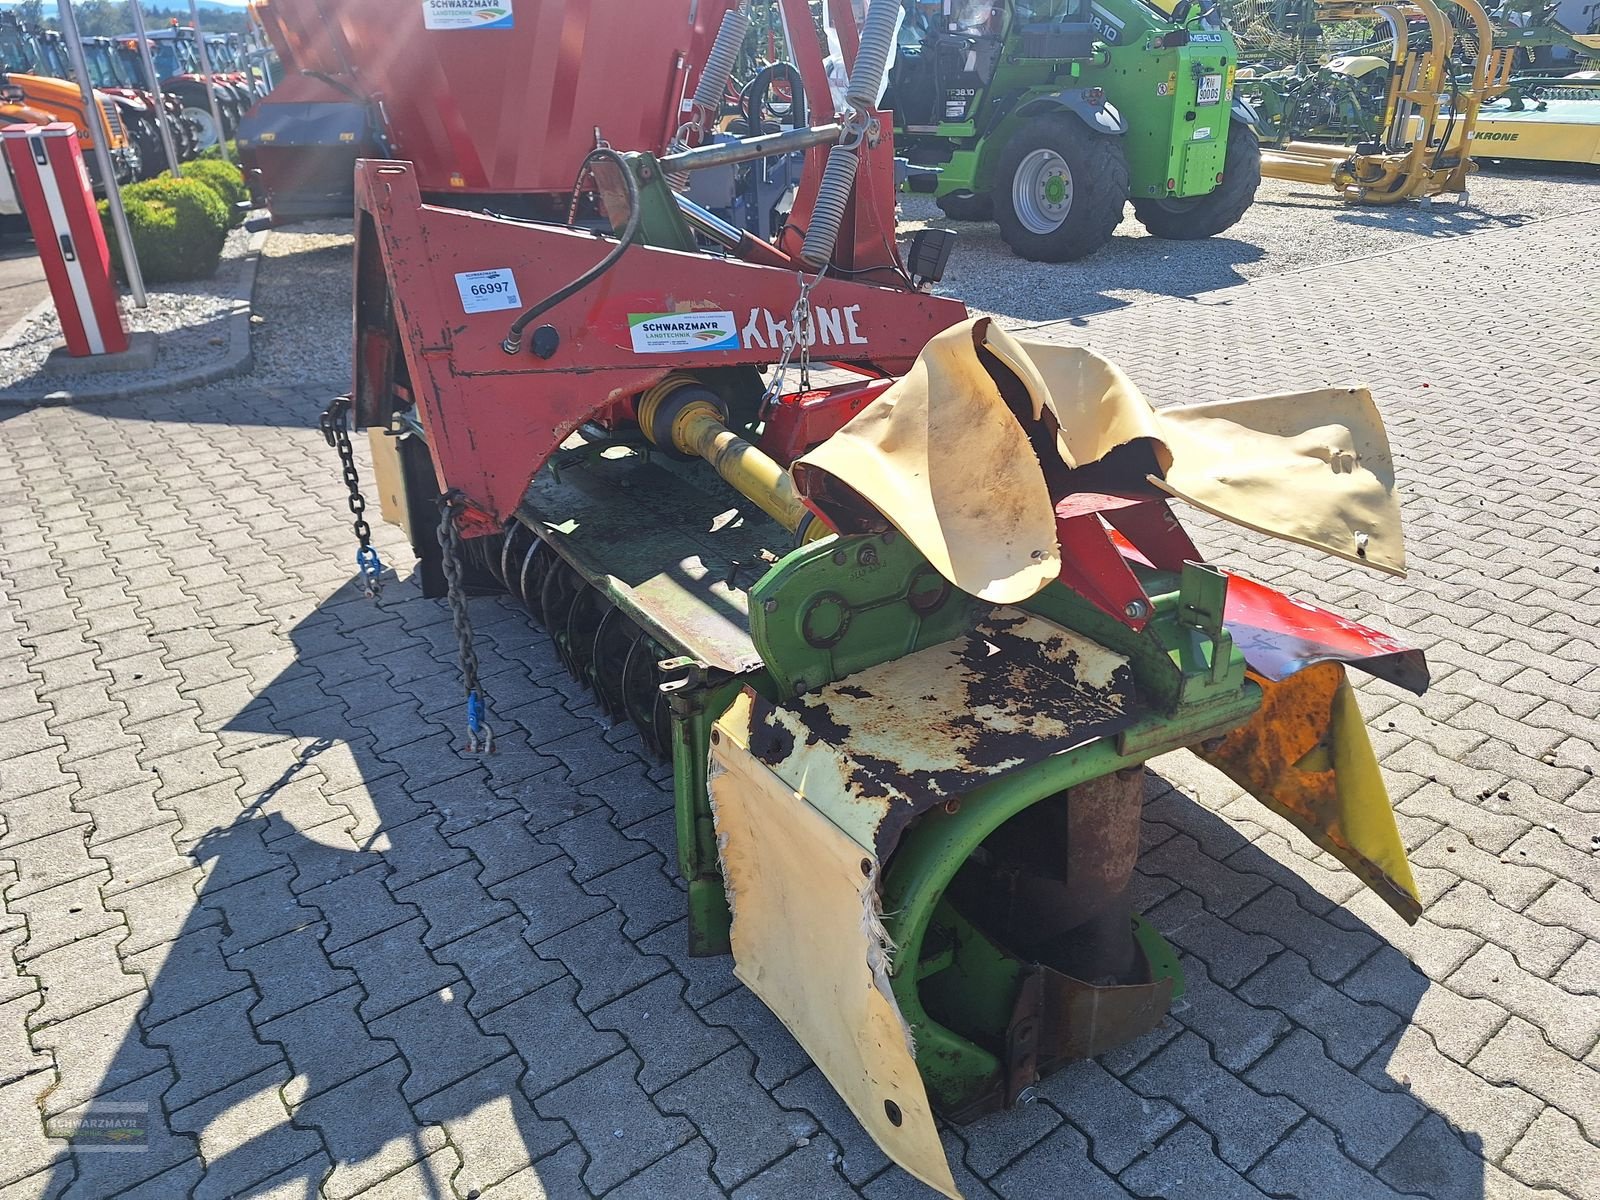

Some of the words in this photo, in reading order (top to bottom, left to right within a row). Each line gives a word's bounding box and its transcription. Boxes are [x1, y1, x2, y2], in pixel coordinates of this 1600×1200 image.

[431, 0, 499, 8] SCHWARZMAYR
[1189, 34, 1221, 42] MERLO
[1474, 131, 1519, 141] KRONE
[471, 281, 509, 296] 66997
[642, 321, 718, 332] SCHWARZMAYR
